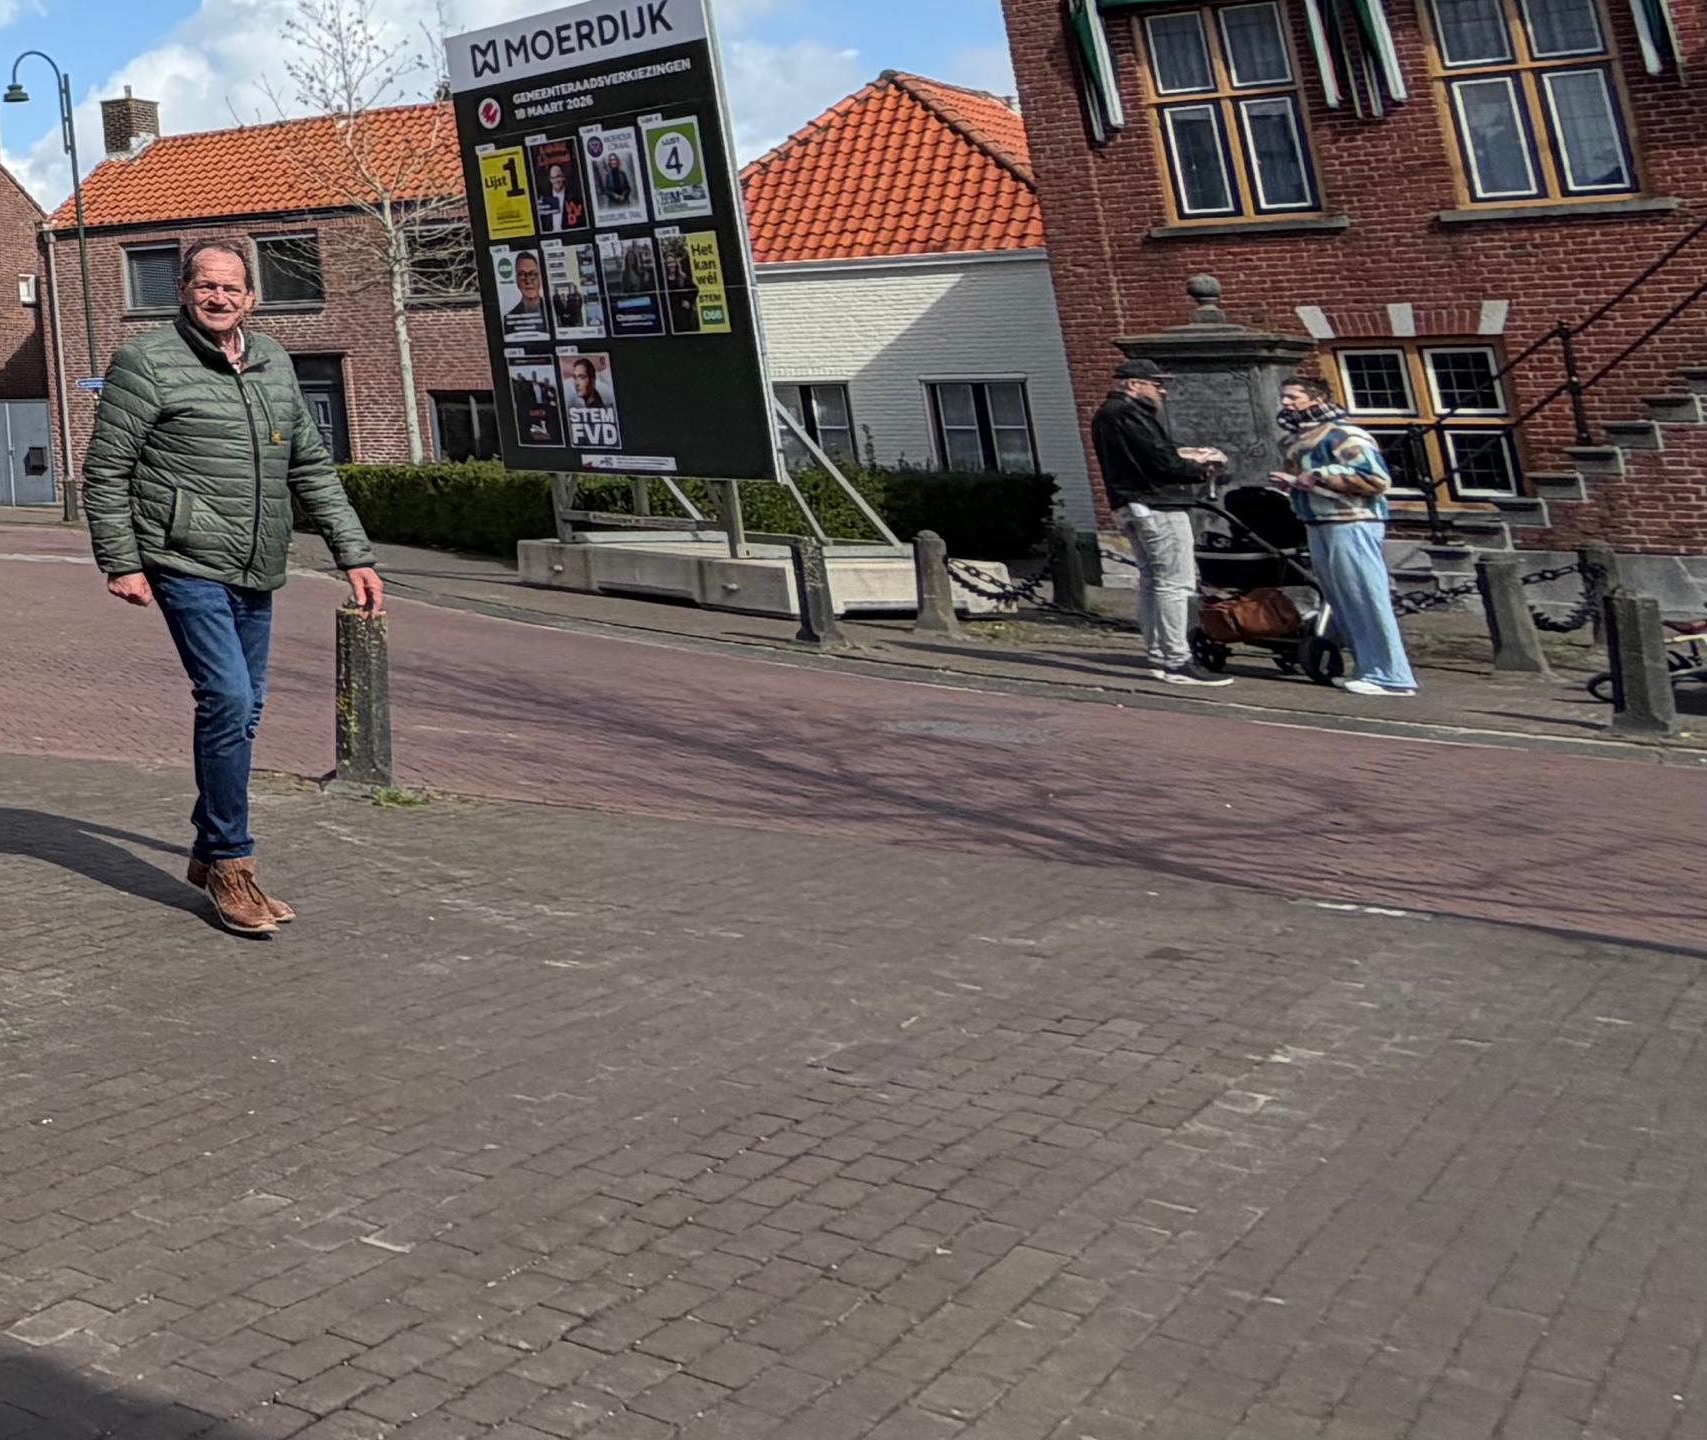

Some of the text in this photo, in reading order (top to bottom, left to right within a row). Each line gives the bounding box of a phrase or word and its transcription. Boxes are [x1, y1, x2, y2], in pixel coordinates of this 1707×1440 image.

[504, 0, 674, 67] MOERDIJK
[512, 57, 692, 105] GEMEENTERAADSVERKIEZINGEN
[527, 101, 564, 118] MAART
[565, 94, 594, 109] 2026
[665, 146, 683, 175] 4
[485, 176, 508, 191] Lijst
[503, 157, 525, 197] 1
[691, 243, 714, 257] Het
[693, 259, 716, 270] kan
[570, 407, 614, 423] STEM
[571, 423, 618, 445] FVD
